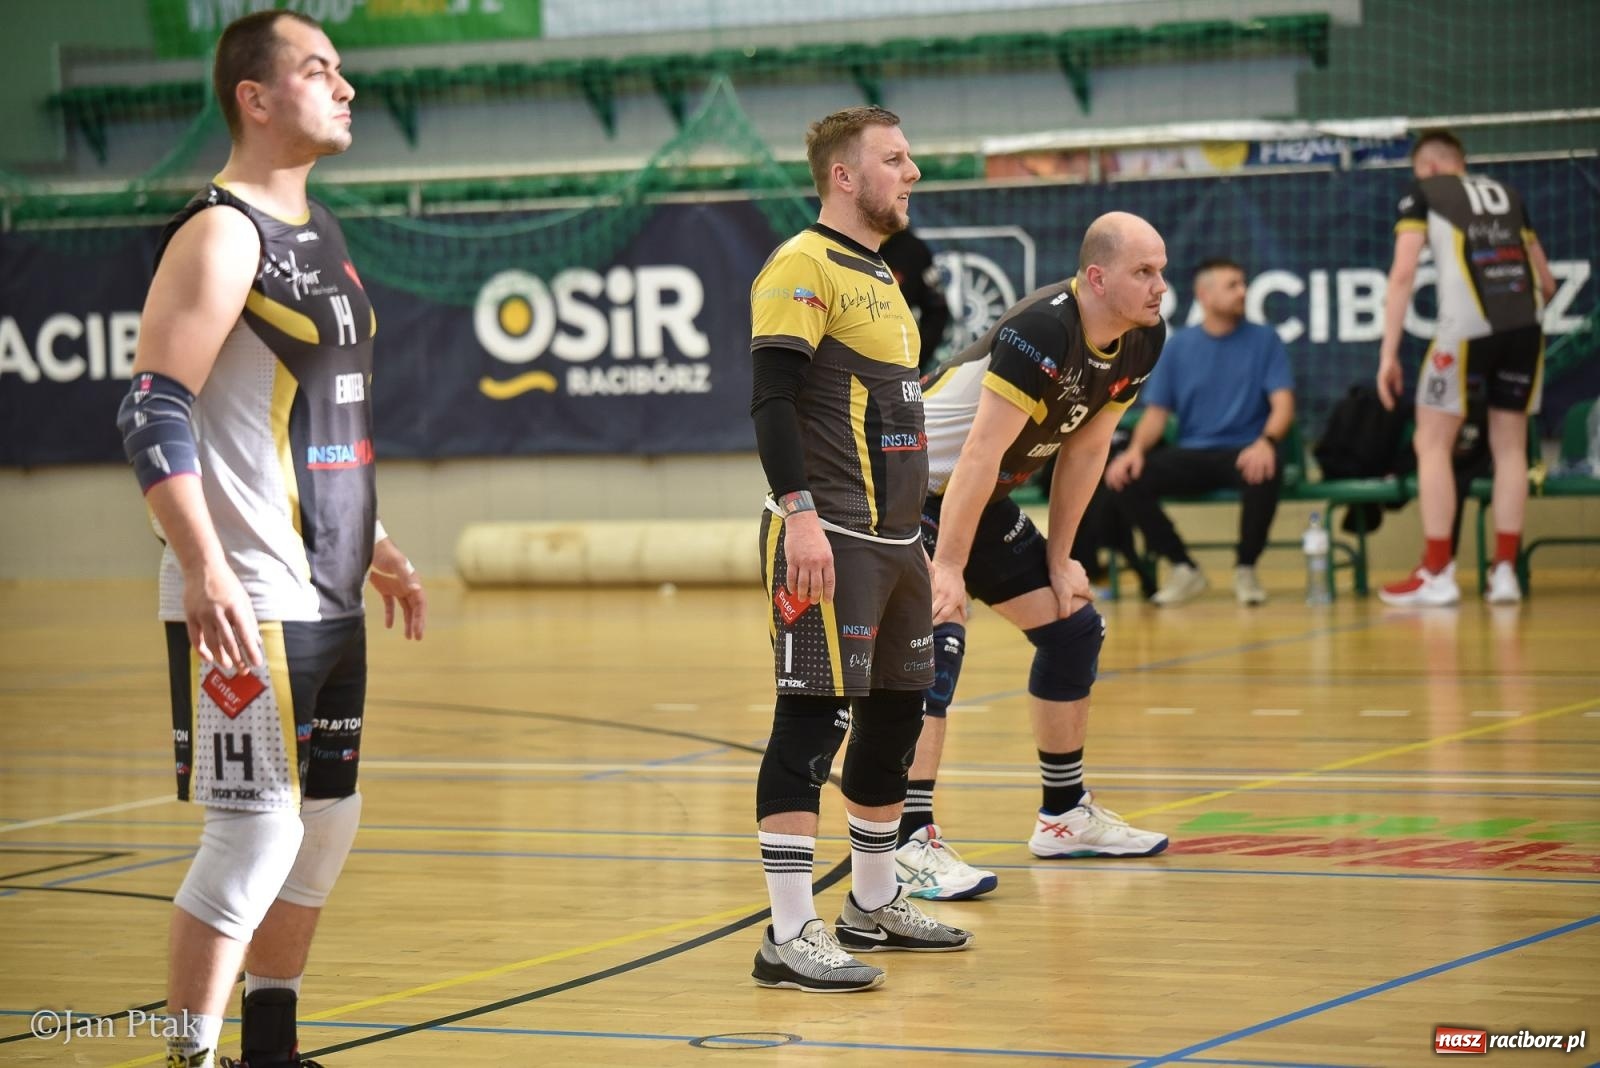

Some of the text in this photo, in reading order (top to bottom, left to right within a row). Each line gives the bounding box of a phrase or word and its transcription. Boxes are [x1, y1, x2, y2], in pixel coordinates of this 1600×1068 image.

[1463, 176, 1511, 216] 10
[0, 312, 143, 383] ACIB
[566, 358, 712, 397] RACIBÓRZ
[209, 672, 243, 706] Enter
[214, 732, 254, 782] 14
